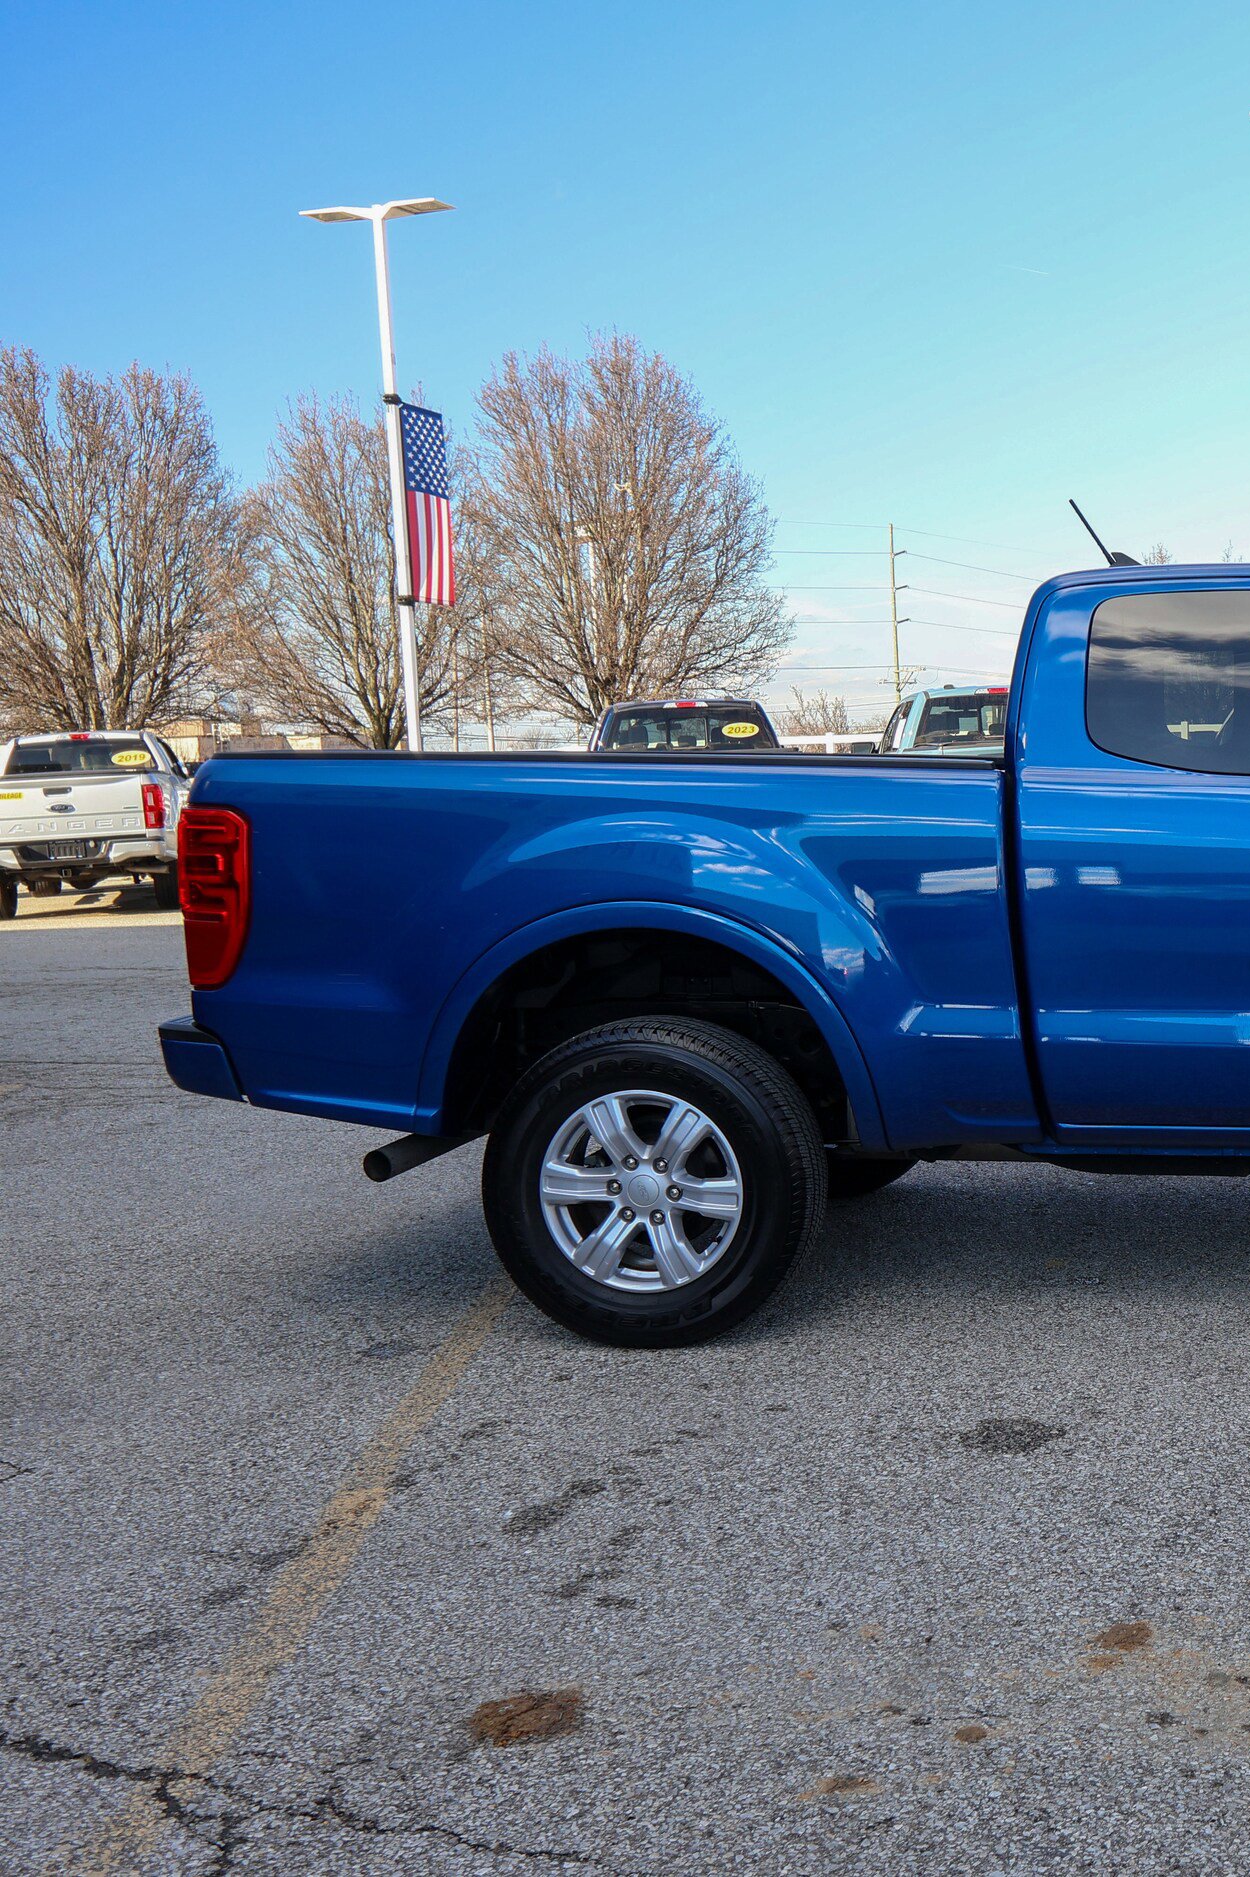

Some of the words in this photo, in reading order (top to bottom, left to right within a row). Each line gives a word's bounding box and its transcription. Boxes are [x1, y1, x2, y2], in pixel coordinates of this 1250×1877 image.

[727, 726, 755, 735] 2023
[117, 753, 146, 763] 2019
[0, 818, 140, 834] ANGER
